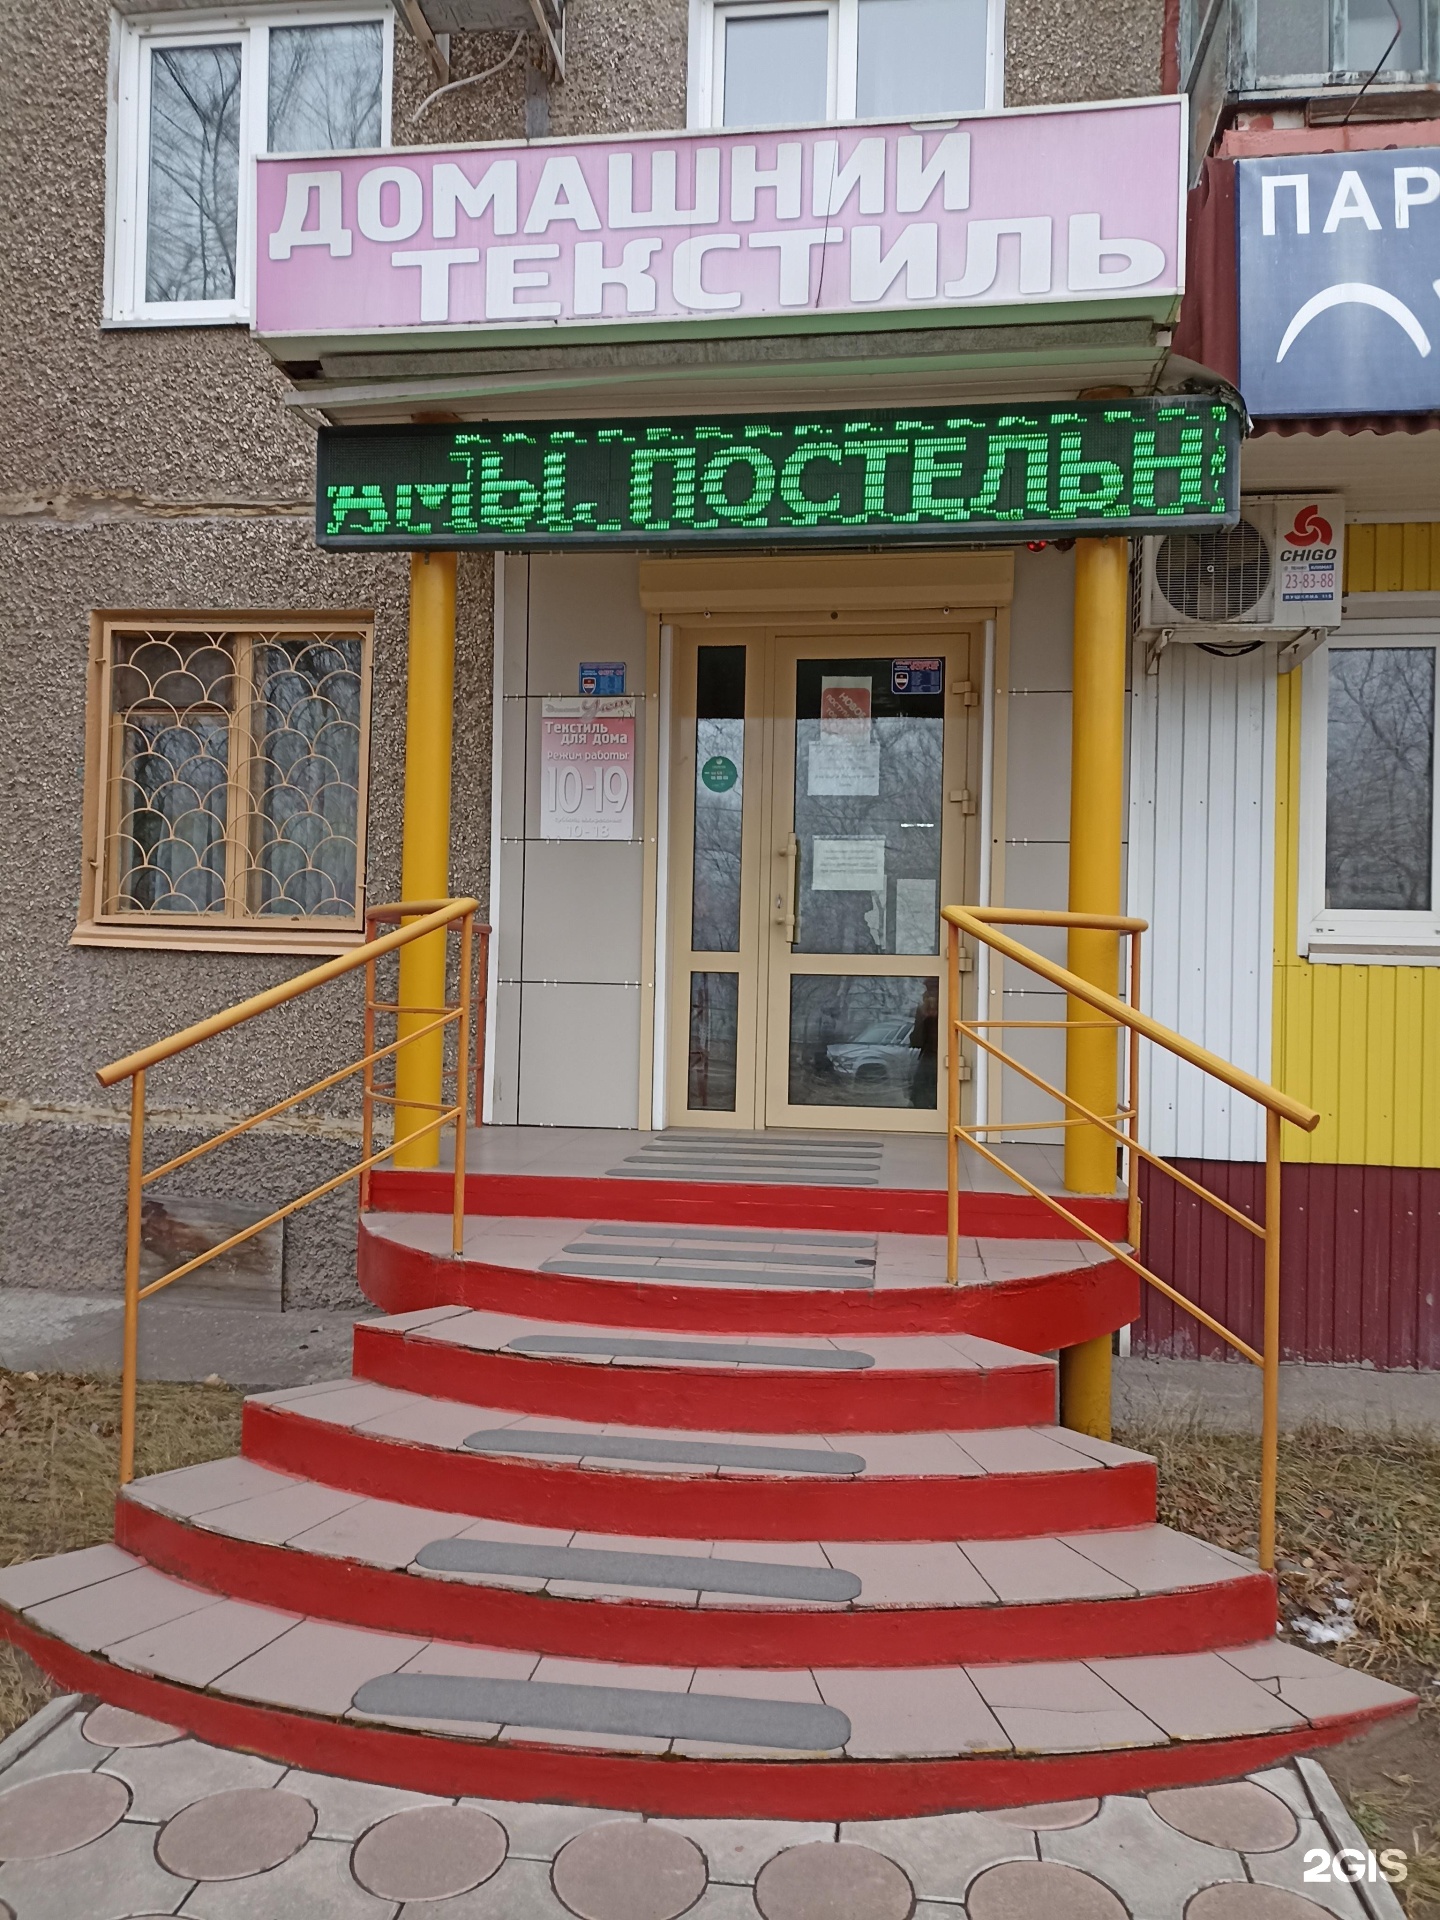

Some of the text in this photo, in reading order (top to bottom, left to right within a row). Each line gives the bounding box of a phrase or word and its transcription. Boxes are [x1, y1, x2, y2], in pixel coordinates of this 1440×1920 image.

[268, 121, 970, 260] ДОМАШНИЙ
[391, 212, 1166, 323] ТЕКСТИЛЬ
[1280, 549, 1337, 561] CHIGO
[1285, 573, 1334, 589] 23-83-88
[545, 722, 609, 734] Текстиль
[561, 733, 628, 746] для дома
[547, 750, 582, 760] Режим
[548, 765, 629, 814] 10-19
[566, 825, 610, 838] 10-18
